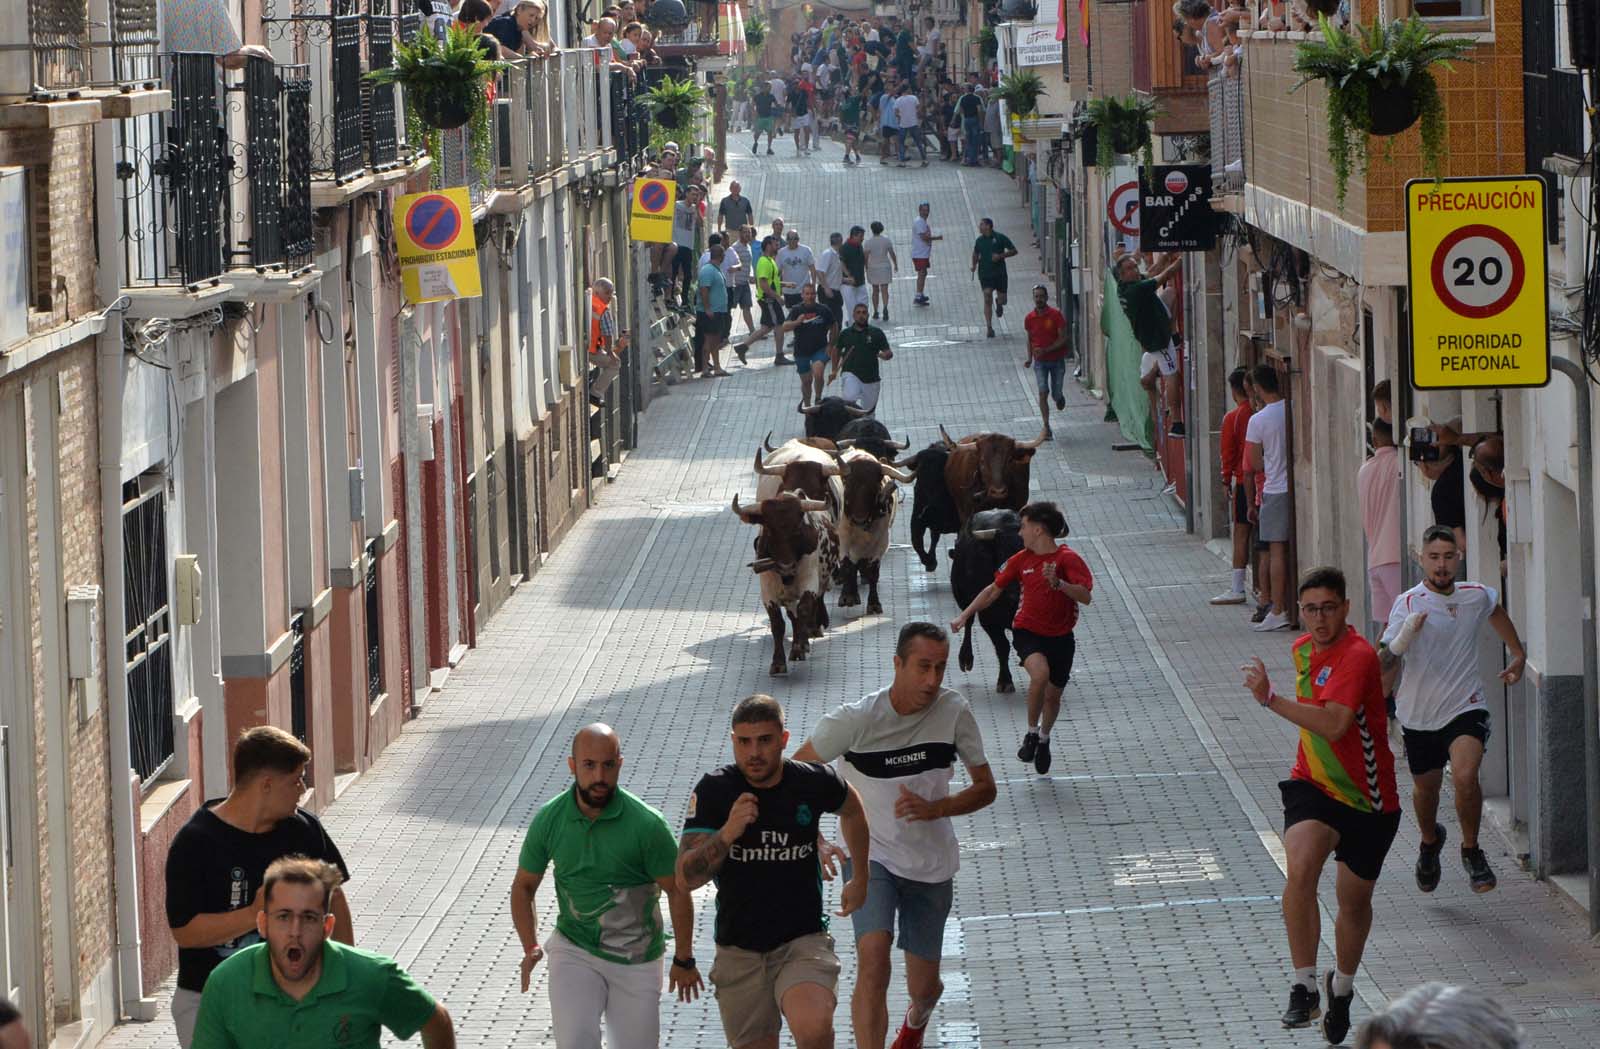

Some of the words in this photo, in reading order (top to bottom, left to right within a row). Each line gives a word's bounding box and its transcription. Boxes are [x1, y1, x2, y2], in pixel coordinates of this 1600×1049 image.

[1145, 196, 1174, 206] BAR
[1418, 185, 1535, 211] PRECAUCIÓN
[401, 254, 435, 266] PROHIBIDO
[436, 248, 476, 261] ESTACIONAR
[1452, 257, 1503, 286] 20
[1438, 334, 1522, 350] PRIORIDAD
[1441, 355, 1520, 371] PEATONAL
[885, 751, 927, 766] MCKENZIE
[761, 831, 788, 846] Fly
[729, 842, 814, 862] Emirates
